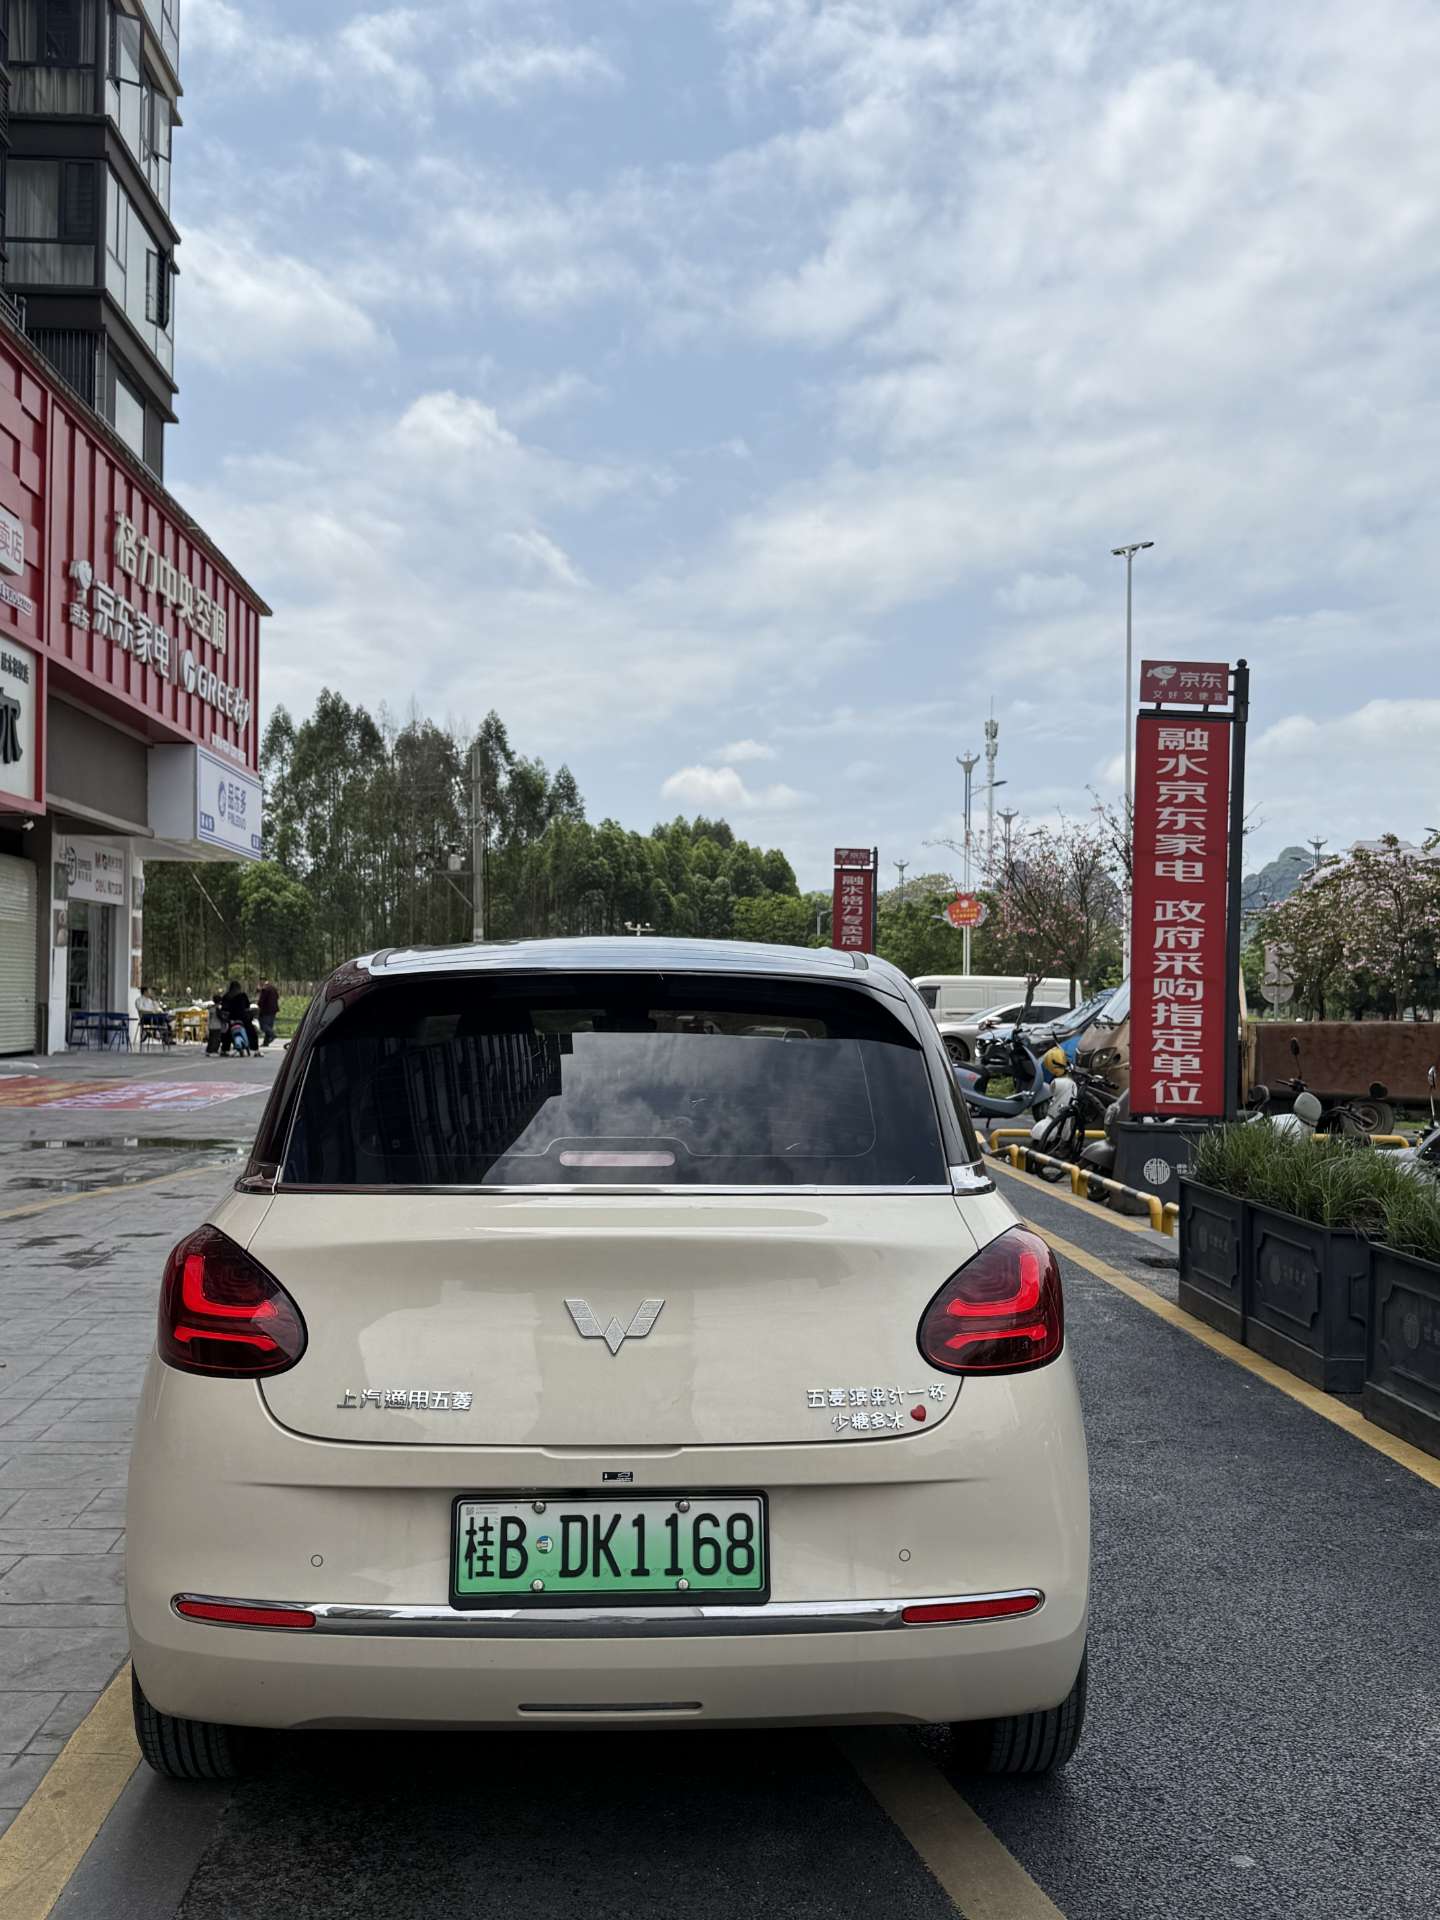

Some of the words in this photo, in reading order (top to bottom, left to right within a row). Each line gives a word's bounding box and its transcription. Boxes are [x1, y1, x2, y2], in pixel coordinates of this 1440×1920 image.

[116, 512, 226, 655] 格力中央空调
[93, 580, 170, 680] 京东家电
[1153, 690, 1224, 701] 又好又便宜
[1180, 672, 1222, 688] 京东
[1154, 727, 1208, 883] 融水京东家电
[841, 875, 864, 945] 融水格力专卖店
[1152, 899, 1206, 1104] 政府采购指定单位
[336, 1388, 473, 1411] 上汽通用五菱
[807, 1383, 946, 1408] 五菱缤果汁一杯
[831, 1411, 905, 1432] 少糖多冰
[465, 1516, 529, 1580] 桂B
